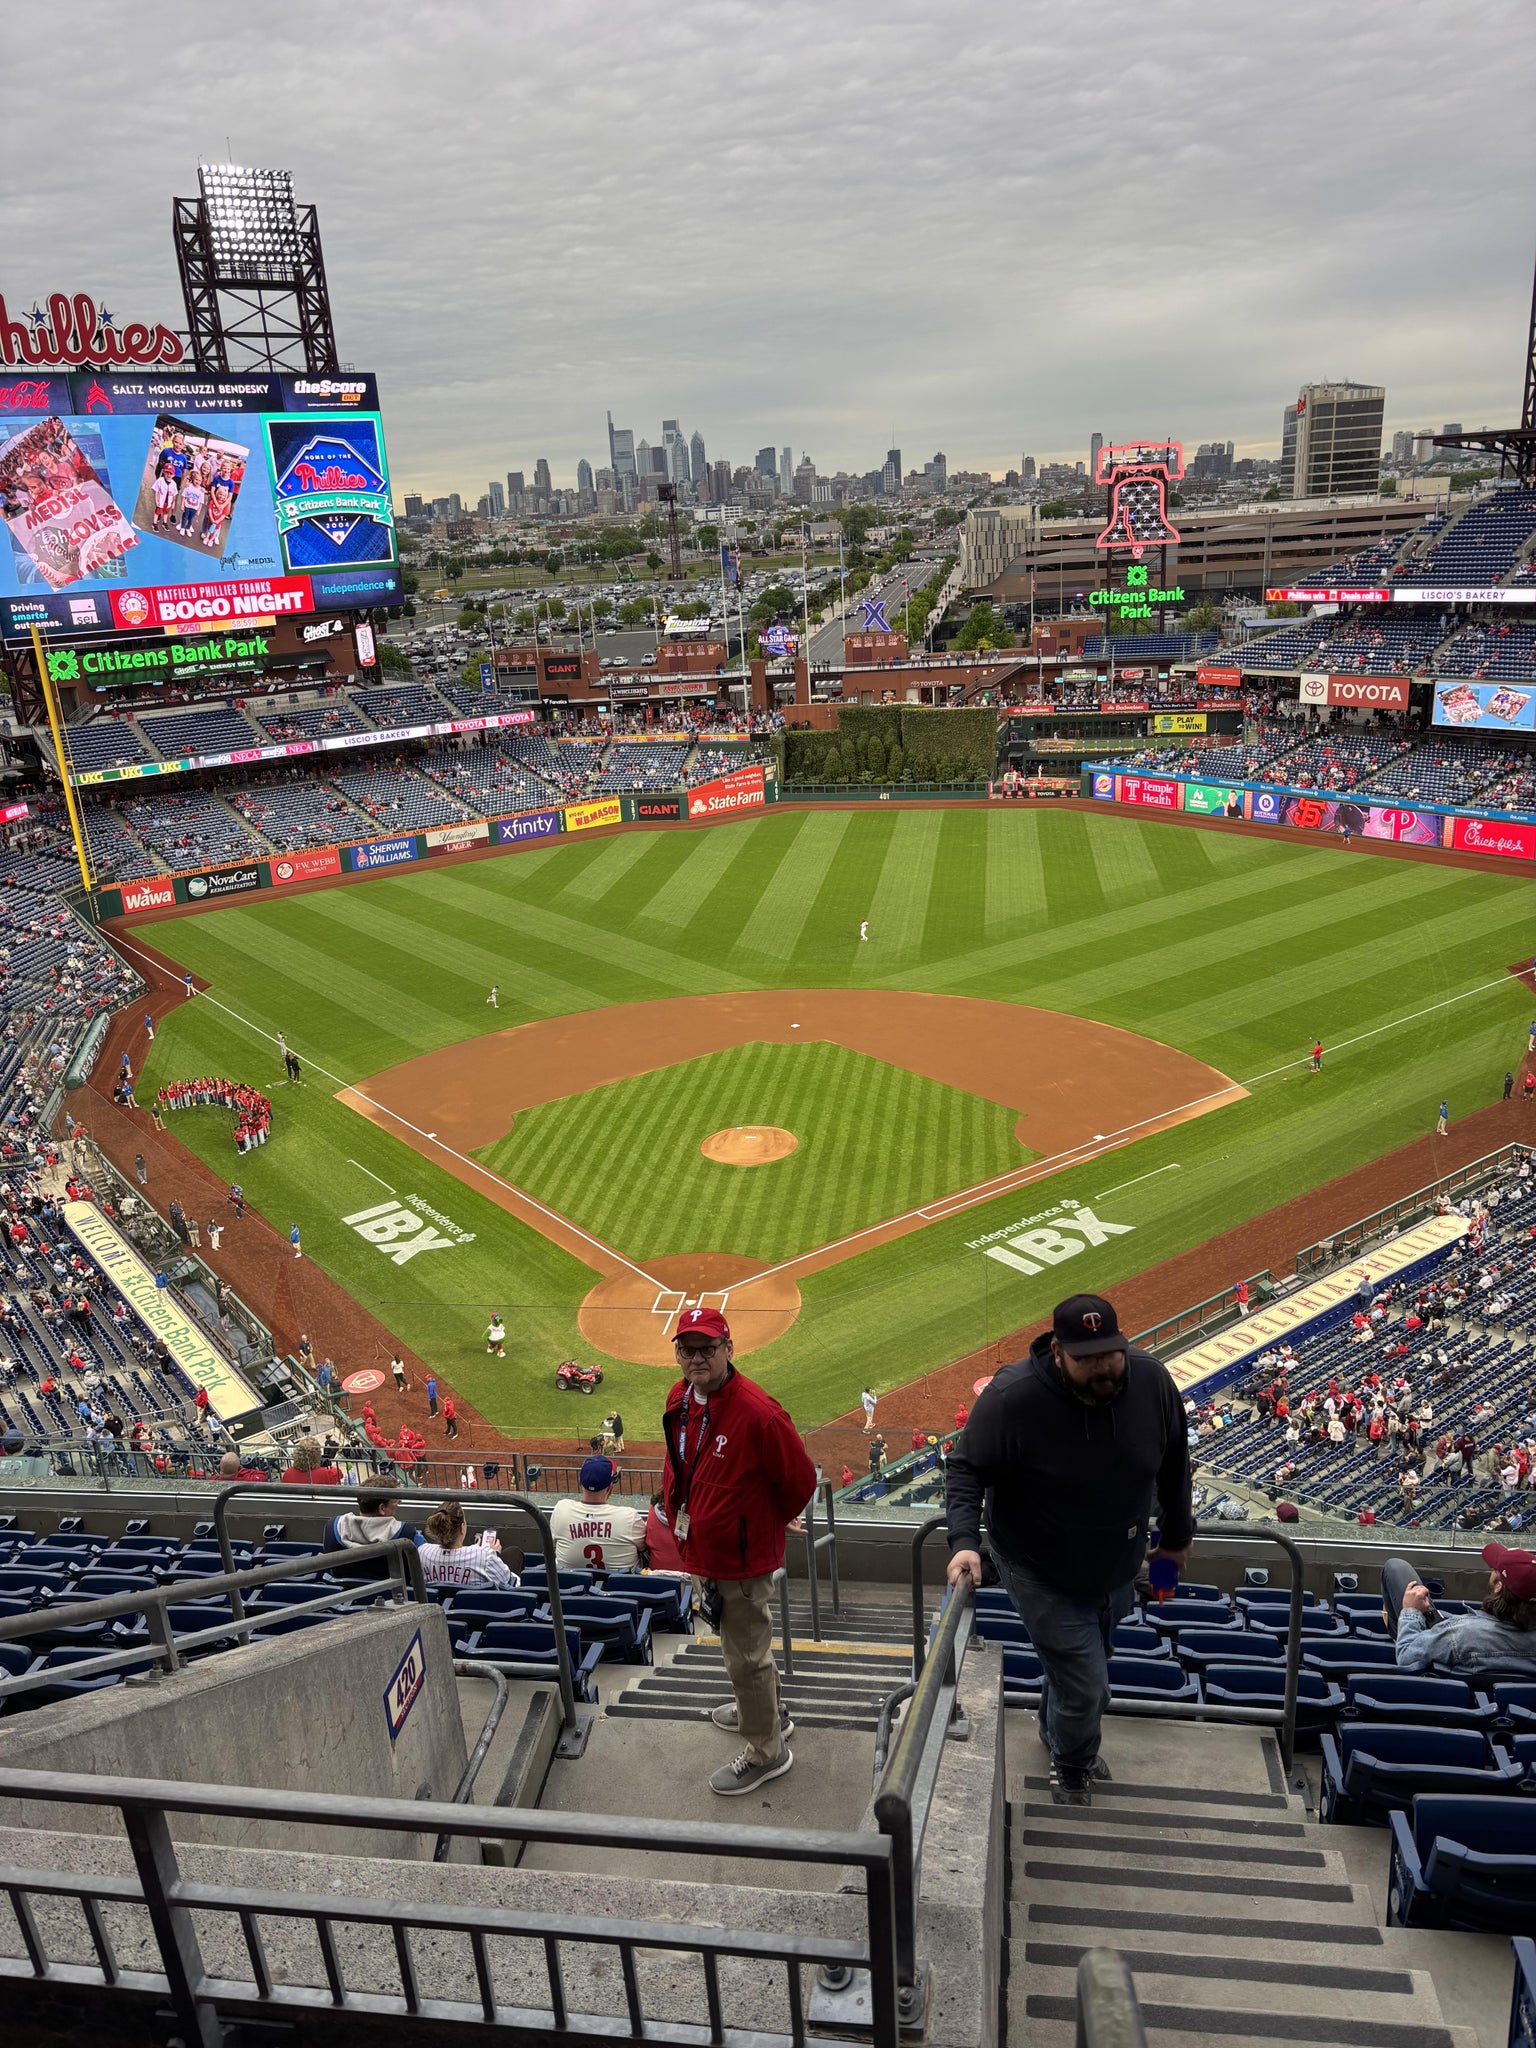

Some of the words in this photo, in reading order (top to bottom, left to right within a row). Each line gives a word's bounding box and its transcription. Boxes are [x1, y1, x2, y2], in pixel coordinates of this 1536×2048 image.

[112, 384, 144, 395] SALTZ
[149, 384, 214, 395] MONGELUZZI
[219, 384, 269, 395] BENDESKY
[147, 400, 187, 409] INJURY
[195, 399, 243, 408] LAWYERS
[293, 463, 367, 491] Phillies
[298, 499, 334, 512] Citizens
[336, 498, 358, 508] Bank
[360, 499, 381, 510] Park
[63, 504, 123, 547] LOVES
[248, 556, 275, 565] MED13L
[156, 586, 197, 602] HATFIELD
[199, 584, 237, 599] PHILLIES
[239, 581, 272, 596] FRANKS
[321, 582, 384, 596] Independence
[1088, 590, 1146, 605] Citizens
[1148, 586, 1185, 602] Bank
[1287, 591, 1310, 600] Phillies
[1311, 591, 1325, 600] win
[1340, 591, 1362, 600] Deals
[1362, 591, 1375, 600] roll
[1375, 591, 1383, 600] in
[1421, 591, 1462, 601] LISCIO'S
[1465, 591, 1506, 601] BAKERY
[10, 603, 45, 613] Driving
[158, 598, 231, 622] BOGO
[233, 591, 305, 614] NIGHT
[1120, 604, 1153, 619] Park
[12, 612, 48, 622] smarter
[664, 615, 711, 631] Fitzpatrick
[862, 600, 892, 632] X
[303, 622, 335, 644] GHOST
[757, 635, 770, 644] ALL
[769, 634, 784, 644] STAR
[783, 633, 800, 643] GAME
[82, 649, 169, 673] Citizens
[170, 640, 224, 664] Bank
[224, 635, 270, 660] Park
[209, 662, 236, 671] ENERGY
[237, 659, 255, 668] DECK
[547, 664, 578, 674] GIANT
[1332, 683, 1402, 702] TOYOTA
[453, 720, 485, 731] TOYOTA
[500, 713, 530, 724] TOYOTA
[1176, 716, 1195, 724] PLAY
[1185, 723, 1202, 731] WIN!
[344, 734, 379, 746] LISCIO'S
[380, 730, 411, 742] BAKERY
[234, 750, 259, 761] NECA
[289, 743, 313, 754] NECA
[119, 766, 143, 779] UKG
[159, 761, 182, 773] UKG
[79, 772, 104, 785] UKG
[1142, 781, 1174, 795] Temple
[879, 792, 890, 800] 401
[1142, 793, 1172, 806] Health
[639, 804, 679, 815] GIANT
[1454, 807, 1484, 817] Independence
[449, 819, 480, 829] ASPLUNDH
[485, 813, 516, 823] ASPLUNDH
[1381, 807, 1417, 842] P
[412, 825, 444, 835] ASPLUNDH
[501, 816, 555, 840] xfinity
[374, 832, 407, 842] ASPLUNDH
[438, 827, 478, 844] Yuengling
[1463, 826, 1525, 854] Chick-fil-A
[293, 846, 329, 856] ASPLUNDH
[334, 839, 368, 849] ASPLUNDH
[369, 840, 410, 857] SHERWIN
[446, 840, 473, 853] LAGER
[209, 860, 246, 871] ASPLUNDH
[252, 853, 288, 864] ASPLUNDH
[311, 857, 337, 867] WEBB
[369, 850, 413, 868] WILLIAMS.
[165, 868, 203, 879] ASPLUNDH
[304, 865, 328, 875] COMPANY
[120, 876, 159, 888] ASPLUNDH
[207, 871, 258, 889] NovaCare
[209, 881, 257, 896] REHABILITATION
[125, 889, 173, 911] Wawa
[404, 1193, 464, 1236] Independence
[340, 1200, 457, 1266] IBX
[963, 1206, 1064, 1250] Independence
[74, 1215, 132, 1270] WELCOME
[982, 1206, 1137, 1276] IBX
[1350, 1220, 1460, 1283] PHILLIES
[690, 1309, 703, 1323] P
[129, 1282, 178, 1330] Citizens
[164, 1327, 203, 1364] Bank
[194, 1356, 231, 1392] Park
[715, 1434, 728, 1454] P
[570, 1521, 612, 1541] HARPER
[583, 1544, 605, 1570] 3
[423, 1564, 472, 1586] HARPER
[396, 1655, 417, 1708] 420
